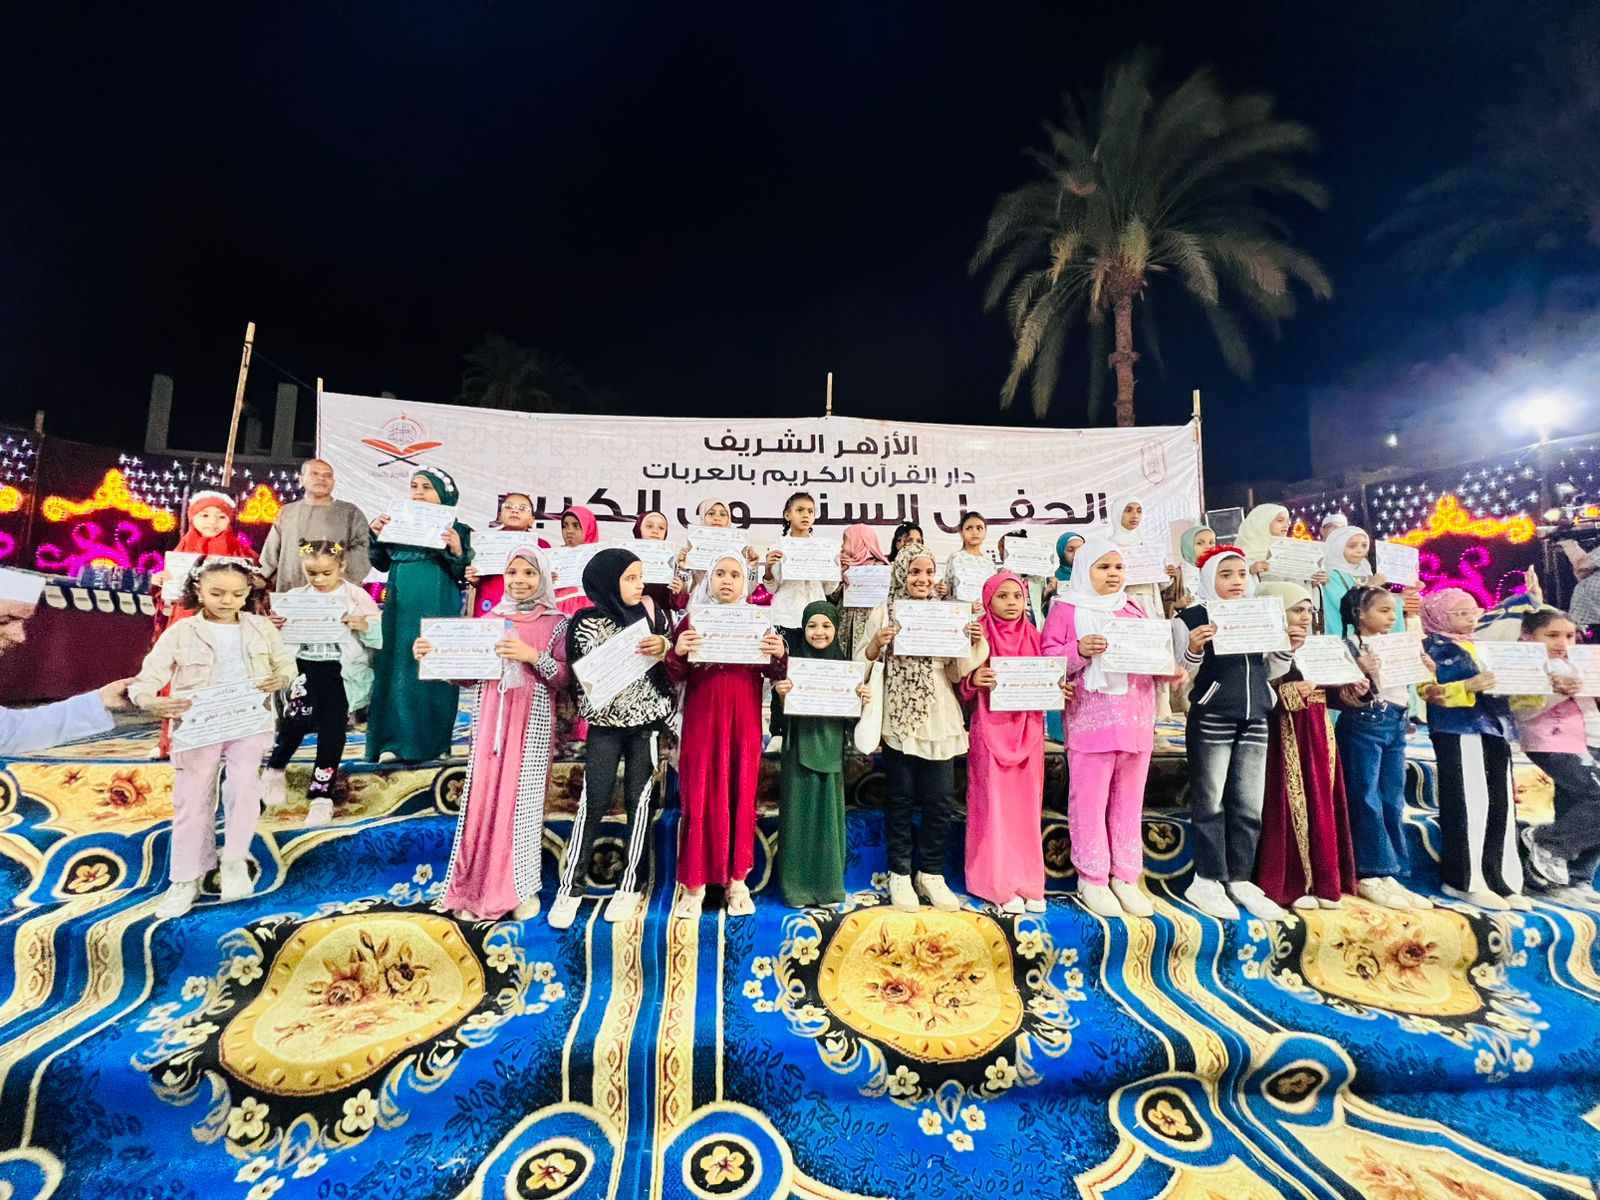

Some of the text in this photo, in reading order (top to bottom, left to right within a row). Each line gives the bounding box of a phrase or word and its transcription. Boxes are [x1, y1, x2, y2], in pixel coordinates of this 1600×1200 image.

[704, 429, 918, 459] الأزهر الشريف
[643, 462, 976, 488] دار القرآن الكريم بالعربات
[934, 489, 1108, 534] الحفل
